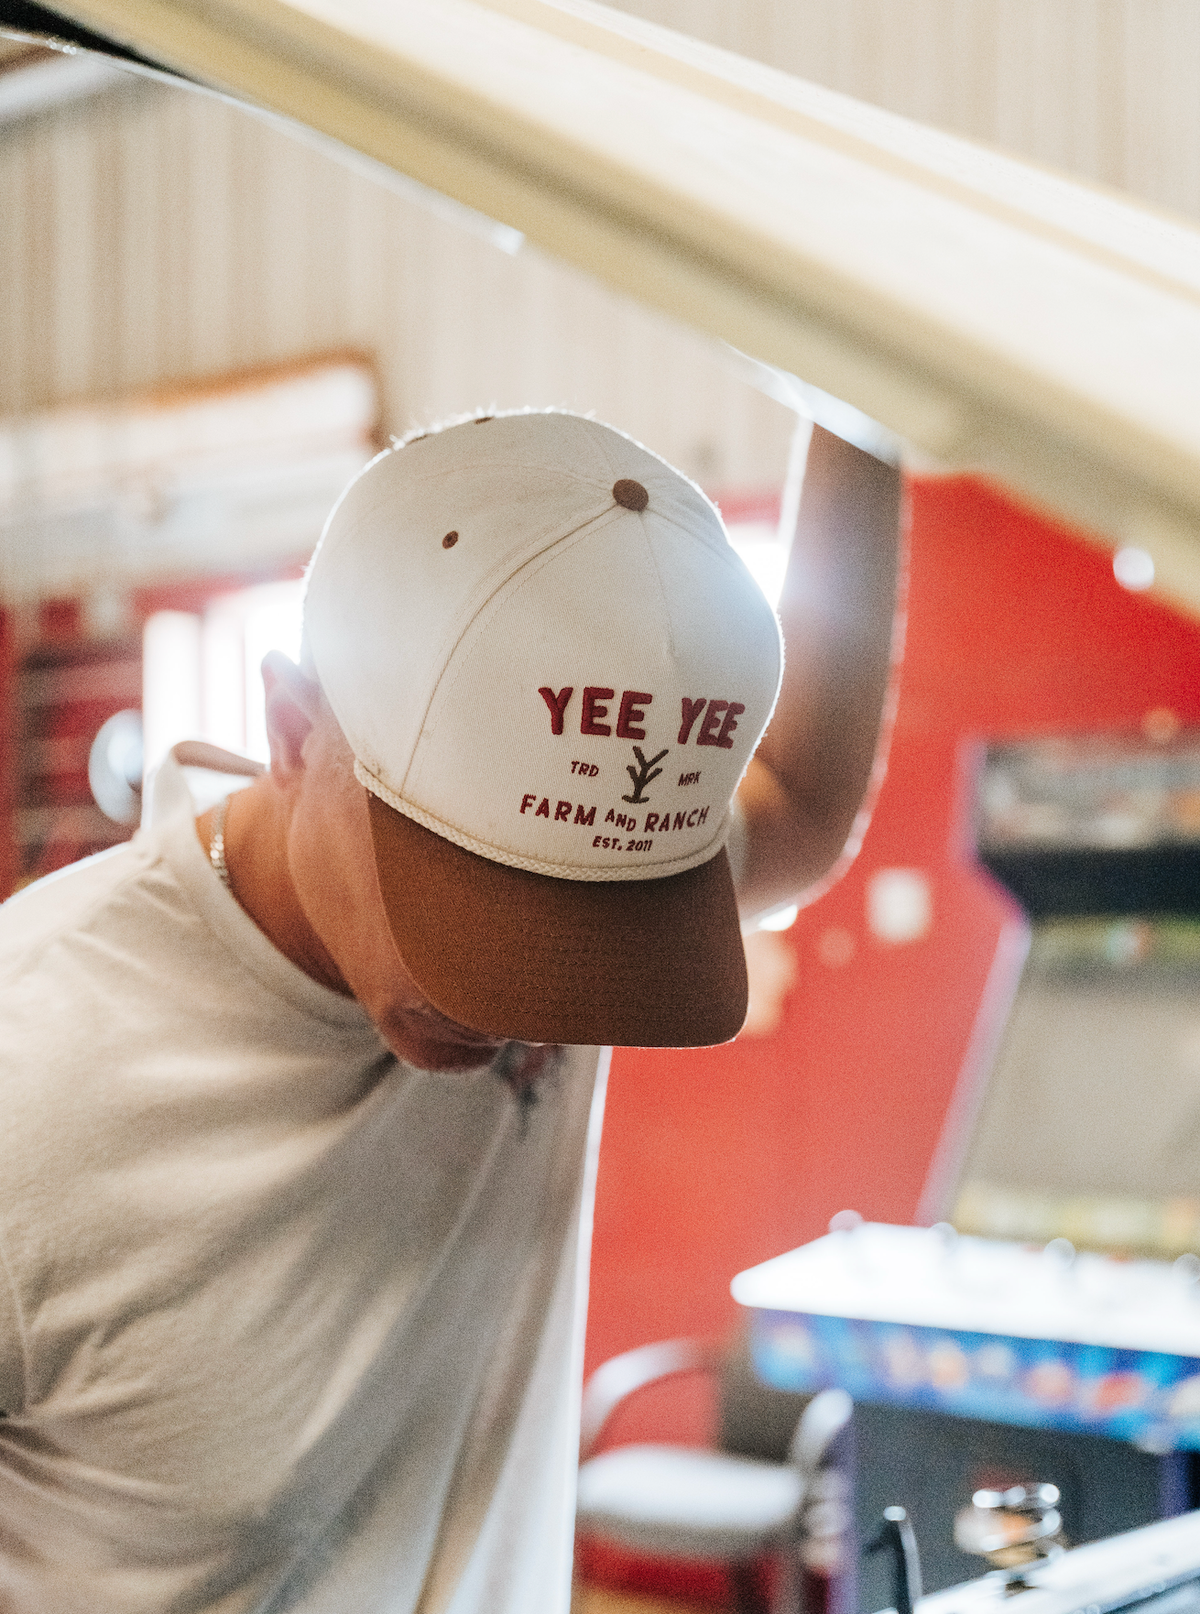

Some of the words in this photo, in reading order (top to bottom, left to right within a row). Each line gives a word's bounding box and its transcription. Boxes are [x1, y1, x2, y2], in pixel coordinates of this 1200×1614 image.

[538, 687, 653, 740] YEE
[677, 697, 746, 749] YEE
[571, 761, 599, 777] TRD
[678, 771, 702, 787] MRK
[519, 794, 597, 826] FARM
[605, 808, 637, 832] AND
[644, 805, 710, 833] RANCH
[592, 836, 622, 851] EST.
[625, 839, 653, 851] 2011
